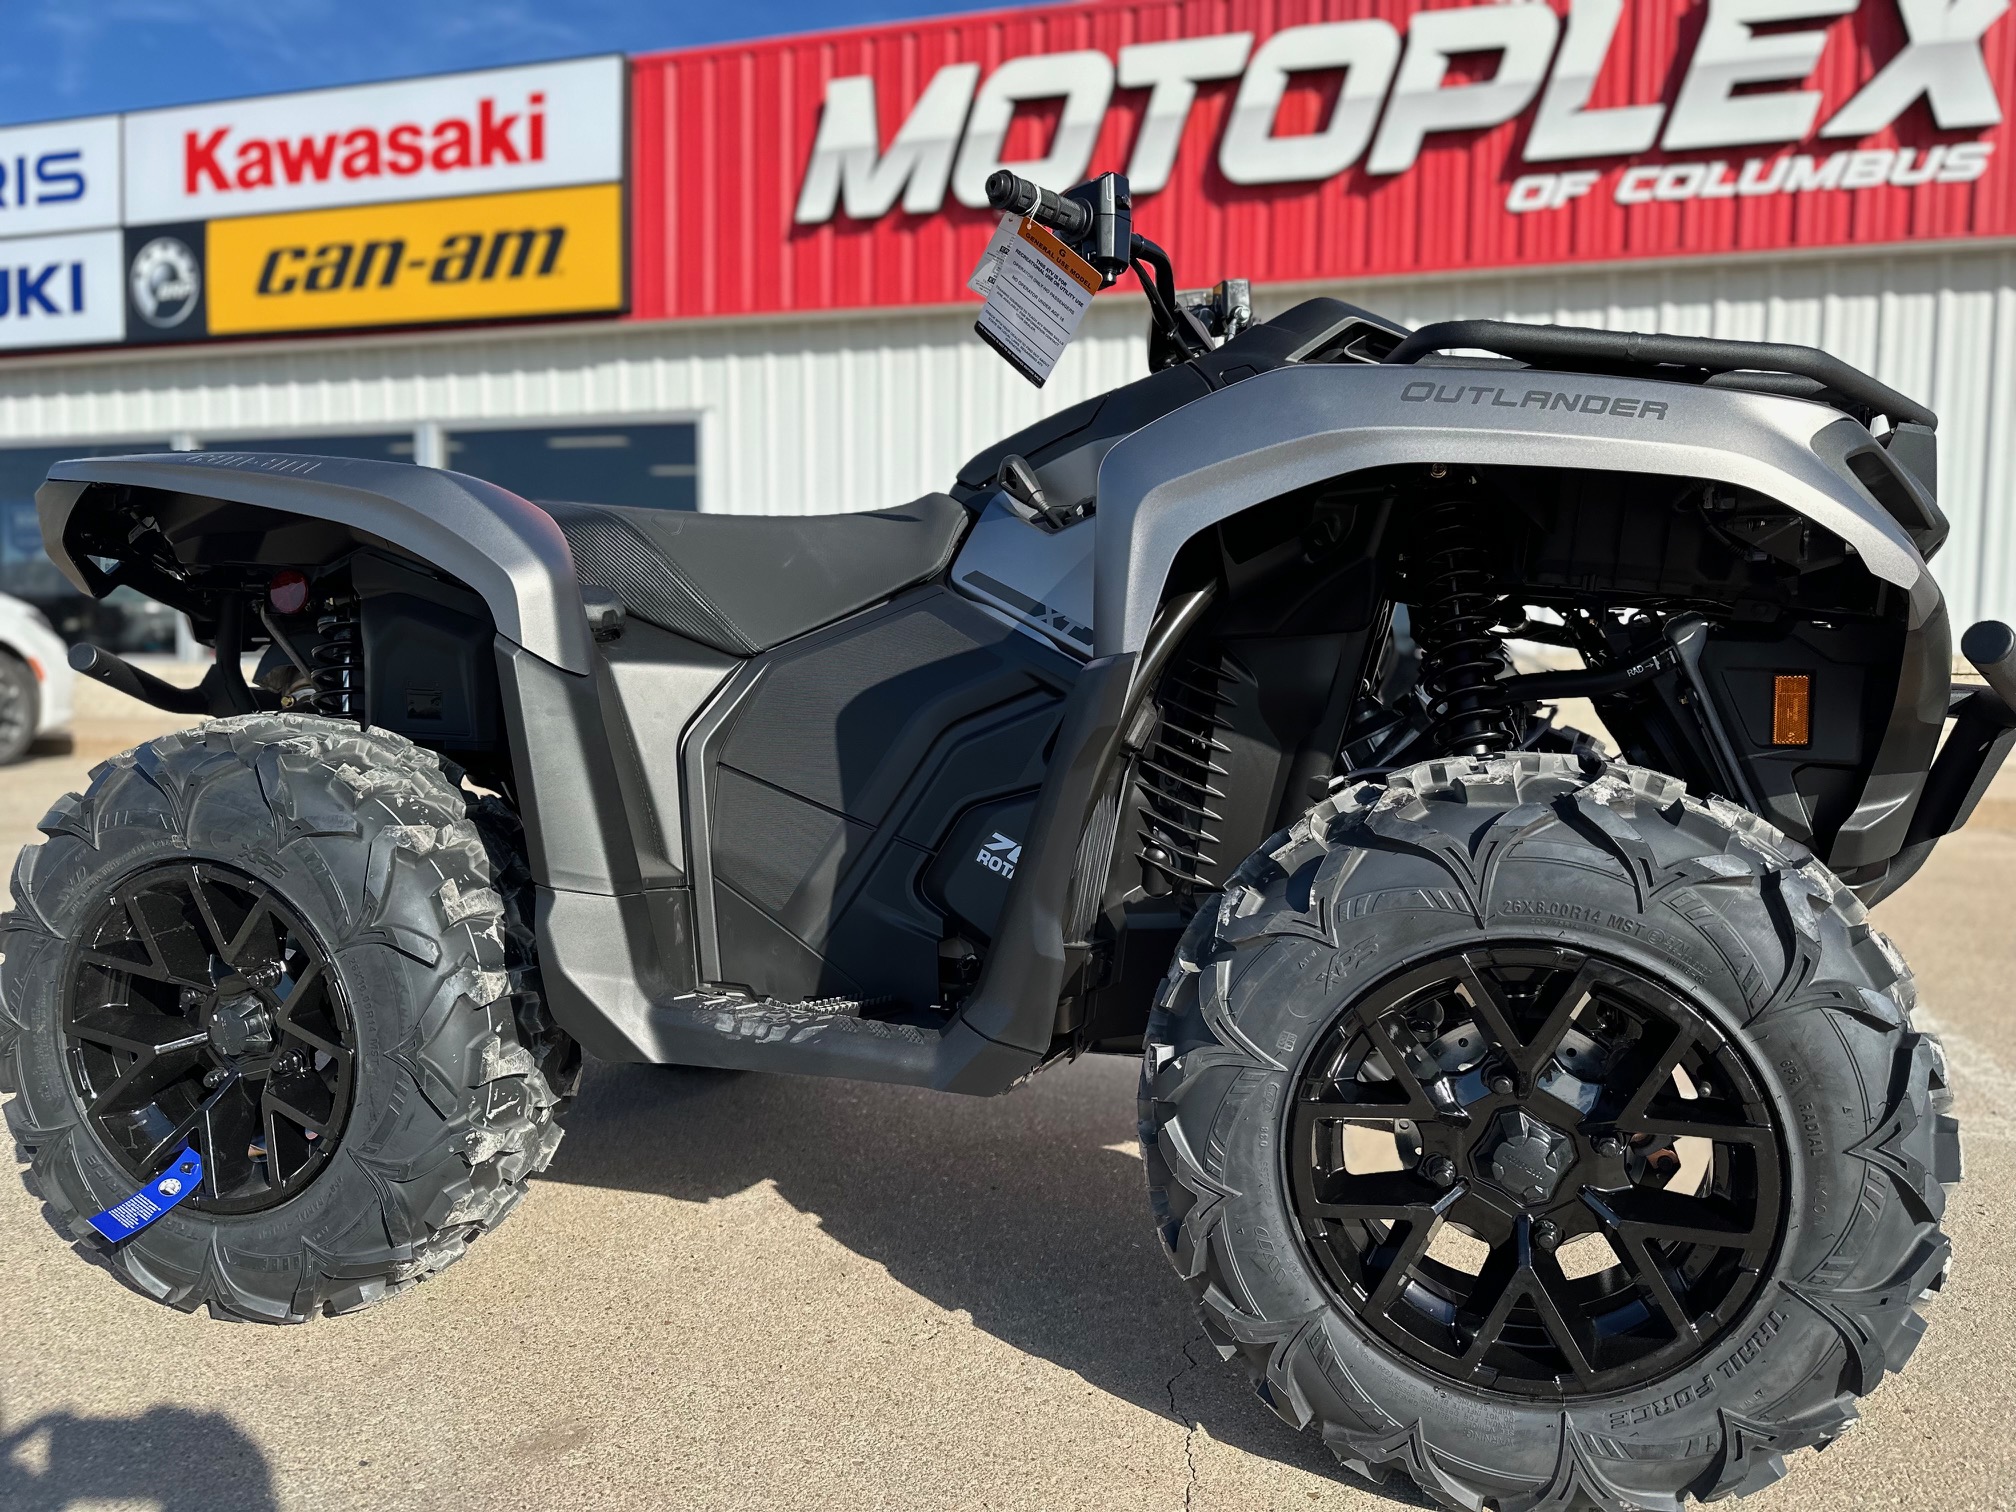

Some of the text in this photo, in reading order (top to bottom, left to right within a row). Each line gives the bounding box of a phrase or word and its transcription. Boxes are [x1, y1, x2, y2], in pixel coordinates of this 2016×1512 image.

[794, 0, 2009, 224] MOTOPLEX
[183, 91, 546, 197] Kawasaki
[0, 151, 87, 209] IS
[1506, 142, 1995, 213] OF COLUMBUS
[256, 224, 568, 297] can-am
[1014, 248, 1045, 275] RECREATIONAL
[1044, 272, 1053, 282] USE
[1059, 285, 1075, 300] UTILITY
[1074, 297, 1084, 307] USE
[1025, 231, 1092, 289] GENERAL USE MODEL
[1035, 258, 1046, 269] THIS
[1045, 266, 1054, 276] ATV
[1057, 277, 1067, 287] FOR
[1058, 247, 1066, 257] G
[0, 262, 84, 320] KI
[1011, 274, 1018, 282] NO
[1017, 279, 1038, 300] OPERATOR
[1037, 297, 1051, 311] UNDER
[1050, 308, 1059, 318] AGE
[1012, 259, 1033, 280] OPERATOR
[1048, 291, 1075, 315] PASSENGERS
[1400, 382, 1669, 420] OUTLANDER
[1627, 665, 1644, 677] RAD
[1503, 899, 1600, 924] 26X8.00R14
[1607, 913, 1646, 936] MST
[368, 1037, 381, 1067] MST
[1799, 1101, 1824, 1156] RADIAL
[1609, 1310, 1789, 1431] TRAIL FORCE
